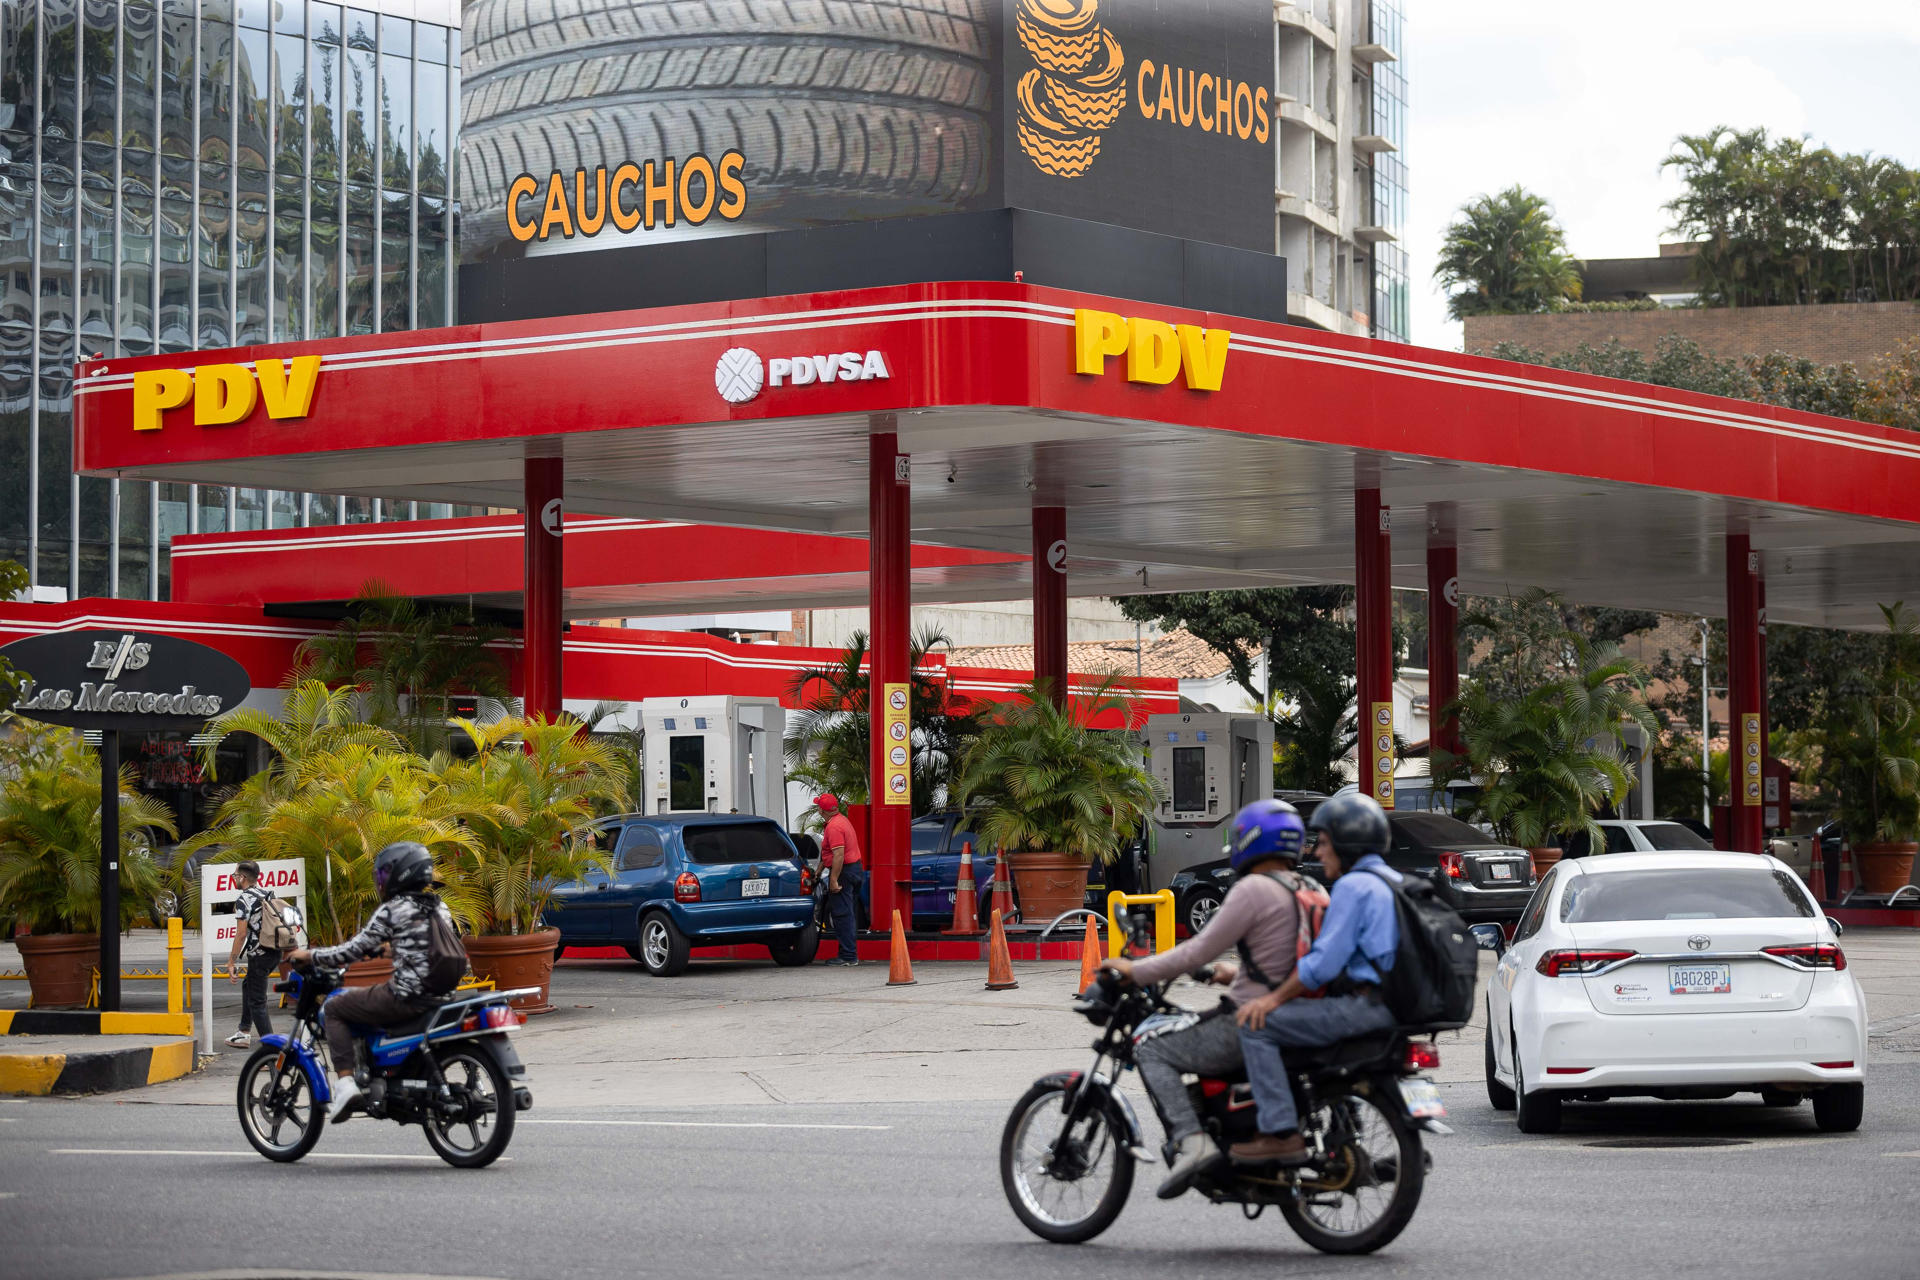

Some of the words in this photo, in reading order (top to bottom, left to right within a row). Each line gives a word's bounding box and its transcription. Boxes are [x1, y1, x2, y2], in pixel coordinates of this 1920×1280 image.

[1137, 59, 1269, 144] CAUCHOS
[506, 149, 748, 242] CAUCHOS
[1074, 308, 1232, 391] PDV
[769, 350, 890, 387] PDVSA
[133, 355, 322, 431] PDV
[549, 503, 563, 532] 1
[1054, 544, 1067, 569] 2
[86, 634, 152, 681] E/S
[13, 679, 74, 710] Las
[73, 682, 223, 715] Mercedes
[140, 740, 192, 757] ABIERTO
[216, 869, 299, 892] ENRADA
[1674, 970, 1726, 987] AB028PJ
